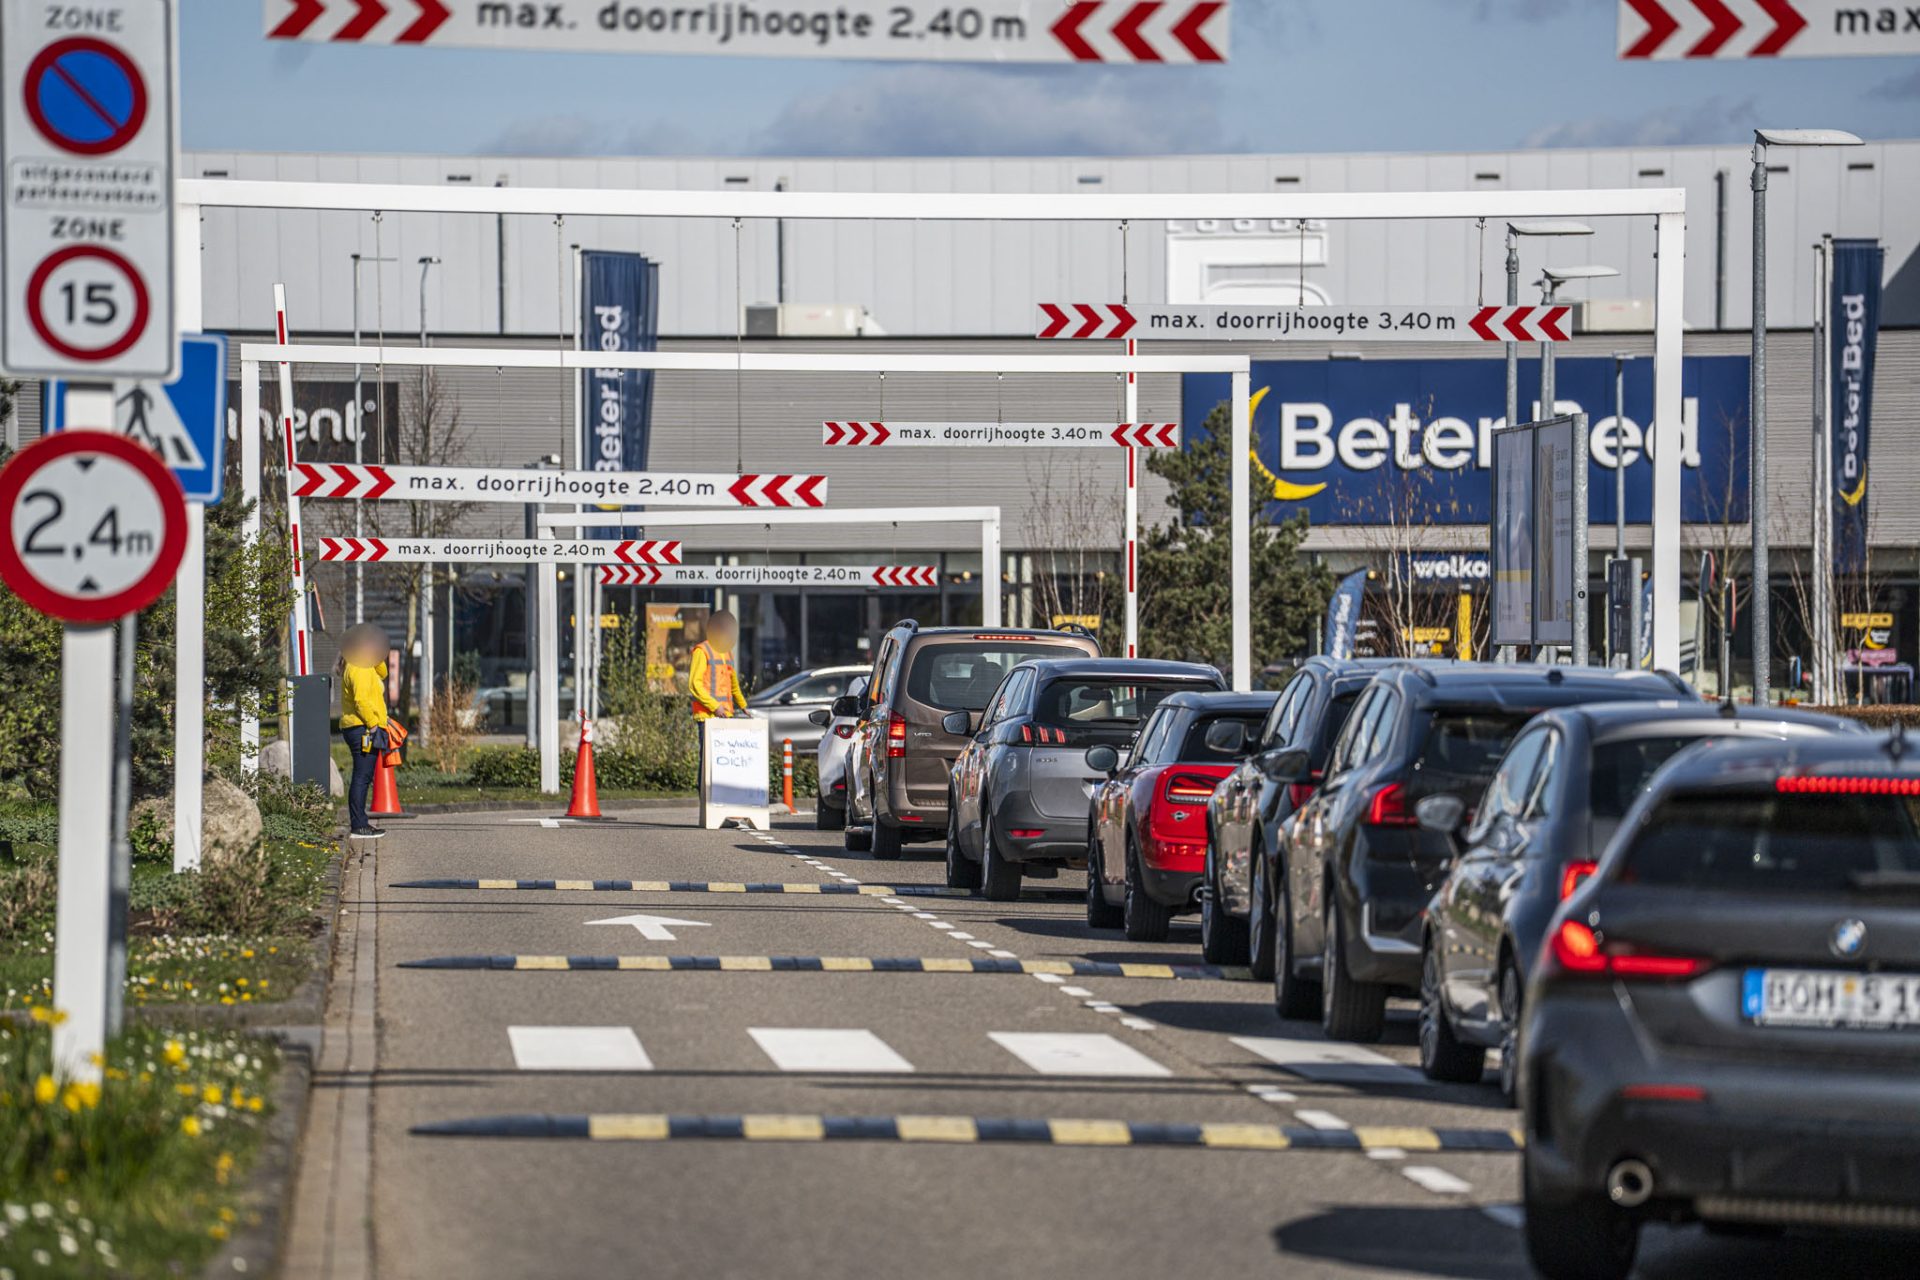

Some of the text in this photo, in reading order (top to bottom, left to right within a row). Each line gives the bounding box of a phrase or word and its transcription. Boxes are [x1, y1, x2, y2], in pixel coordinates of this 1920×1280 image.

[45, 5, 124, 32] ZONE
[477, 0, 1026, 46] max. doorrijhoogte 2.40 m
[51, 215, 126, 241] ZONE
[61, 281, 118, 325] 15
[1150, 313, 1204, 330] max.
[1216, 311, 1369, 335] doorrijhoogte
[1436, 317, 1456, 331] m
[899, 427, 936, 440] max.
[943, 426, 1046, 443] doorrijhoogte
[1089, 429, 1103, 439] m
[1280, 402, 1507, 470] Beter
[410, 475, 465, 490] max.
[476, 474, 630, 499] doorrijhoogte
[696, 482, 716, 495] m
[398, 544, 436, 555] max.
[443, 541, 548, 559] doorrijhoogte
[592, 546, 606, 556] m
[675, 569, 709, 580] max.
[715, 567, 809, 583] doorrijhoogte
[848, 570, 862, 580] m
[1413, 554, 1490, 579] welko
[1897, 978, 1920, 1013] 1
